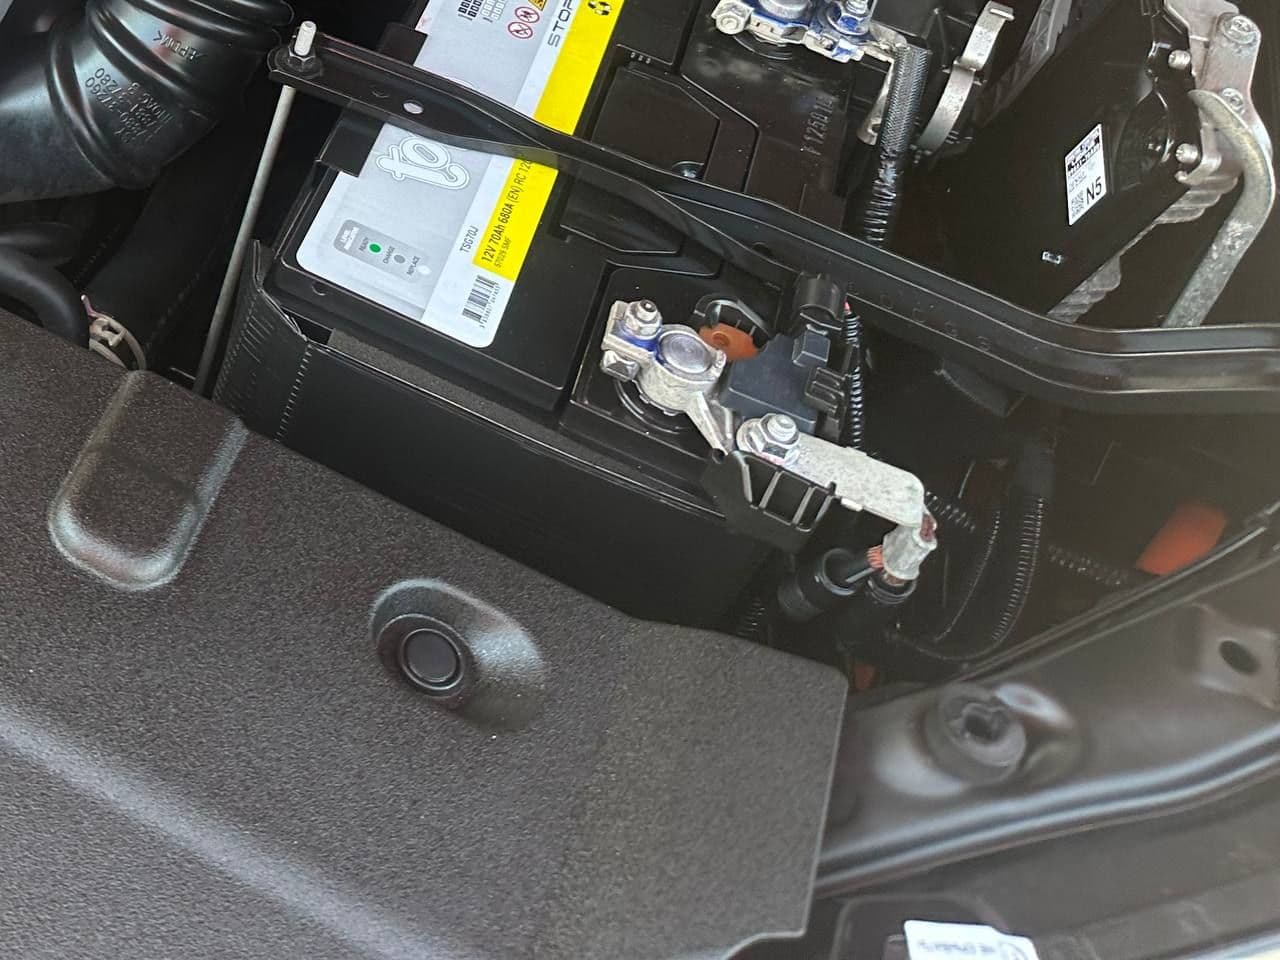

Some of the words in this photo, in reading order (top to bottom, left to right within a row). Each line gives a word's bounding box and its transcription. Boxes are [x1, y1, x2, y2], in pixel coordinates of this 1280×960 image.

[508, 185, 523, 206] (EN)
[1086, 175, 1103, 205] N5
[497, 200, 515, 225] 680A
[459, 225, 480, 254] TSG70J
[489, 221, 508, 246] 70Ah
[481, 244, 497, 265] 12V
